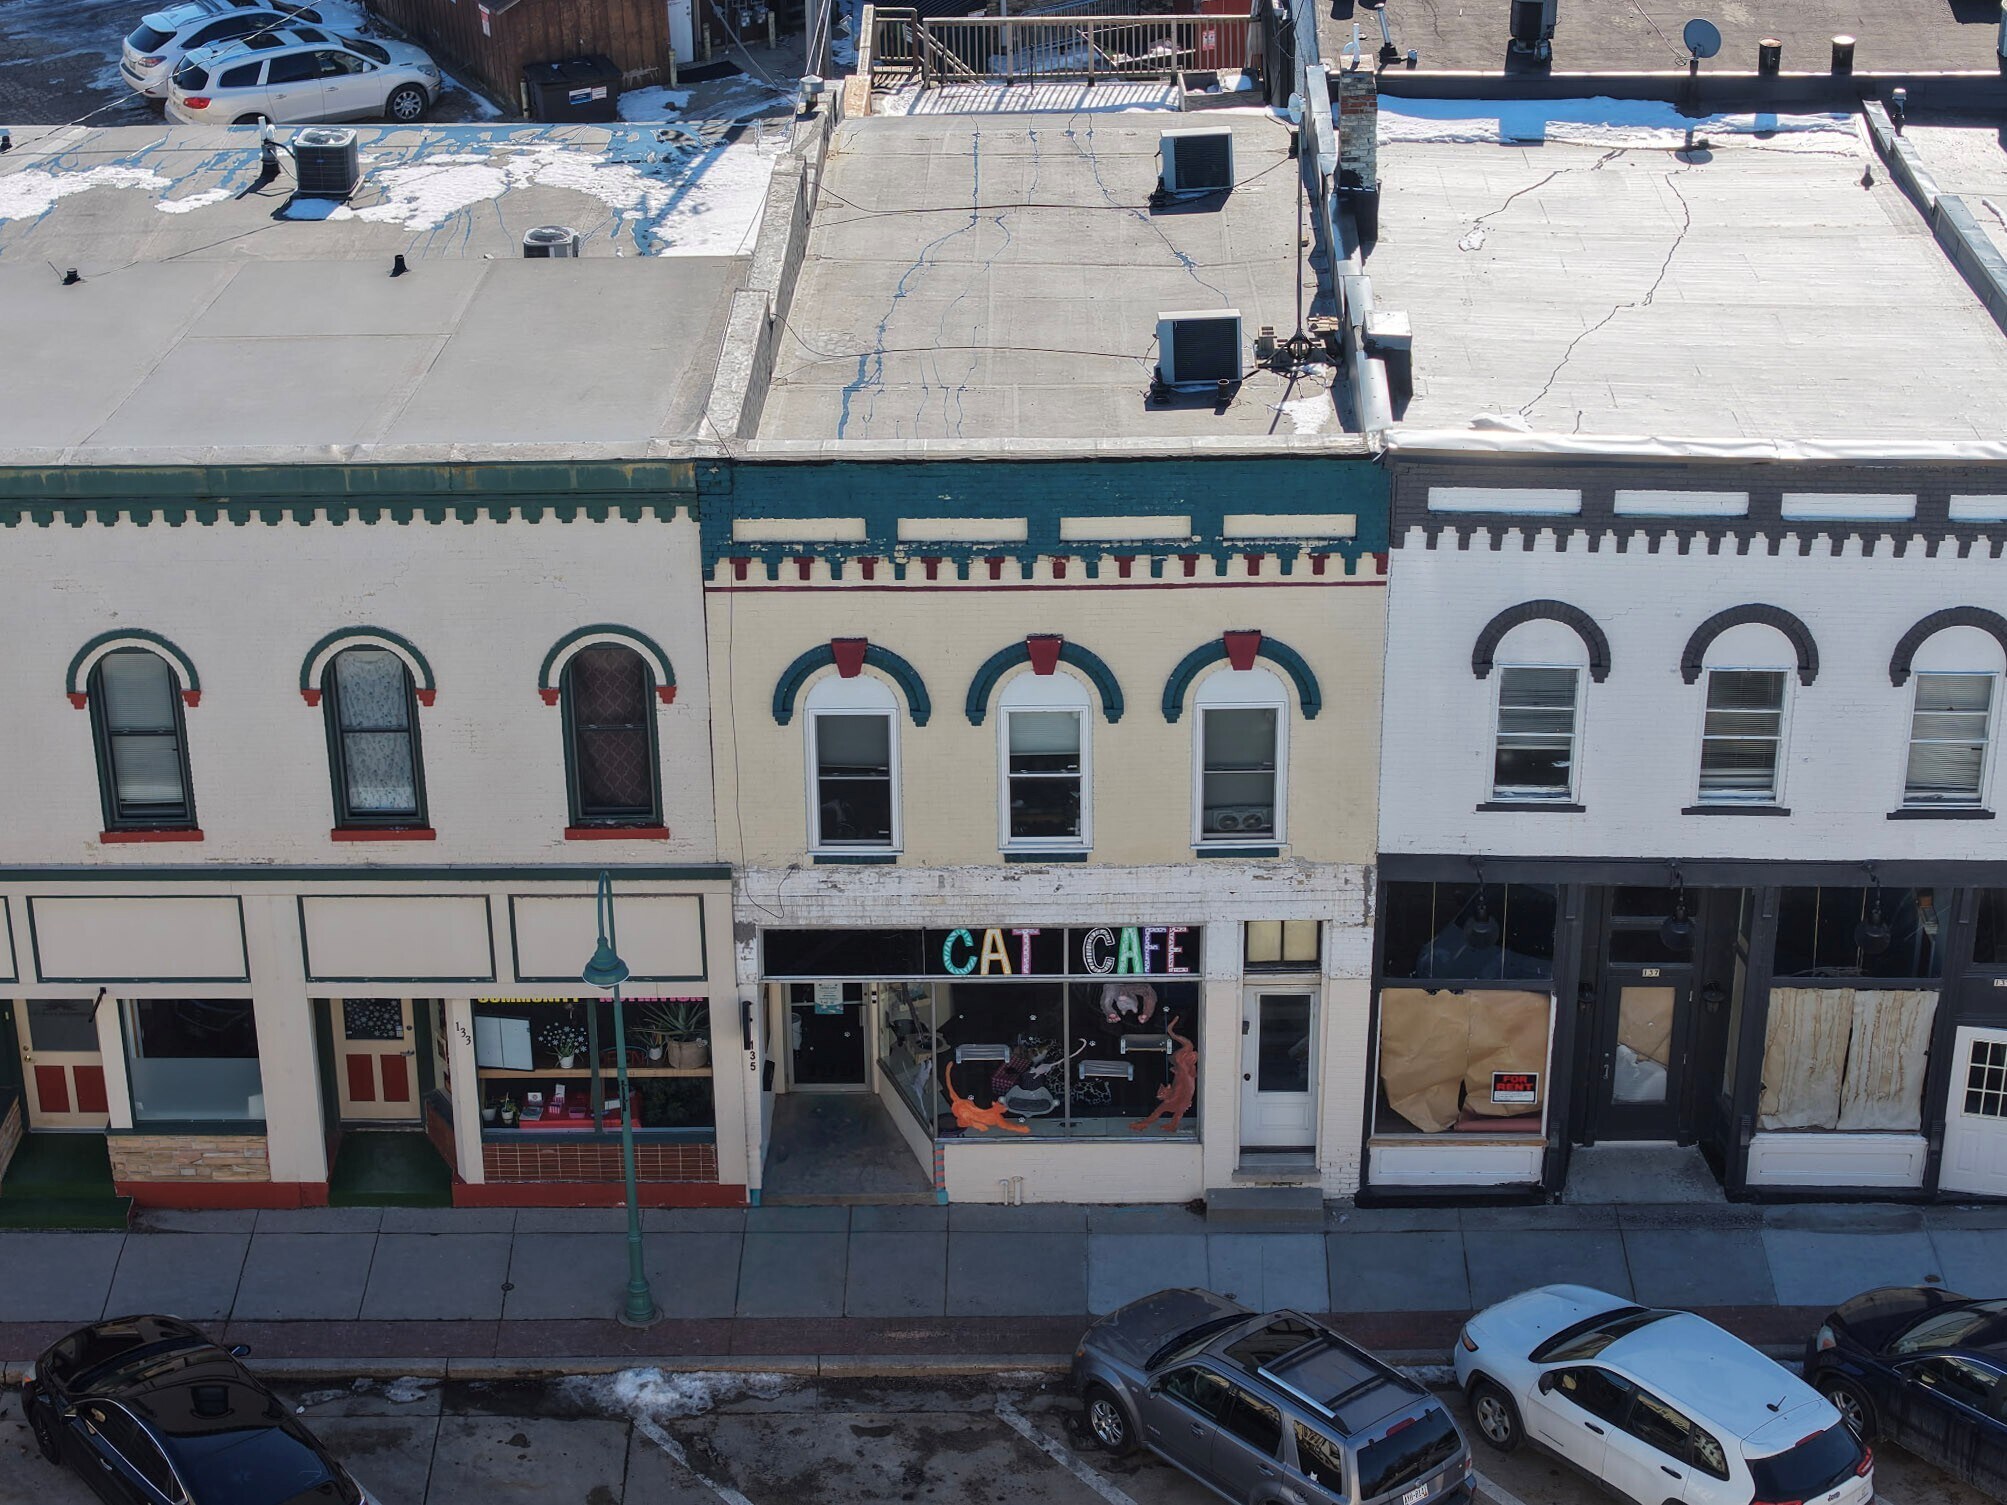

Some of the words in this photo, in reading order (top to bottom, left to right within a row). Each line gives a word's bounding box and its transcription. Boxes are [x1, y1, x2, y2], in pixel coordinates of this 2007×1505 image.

[942, 927, 1041, 975] CAT
[1082, 926, 1189, 975] CAFE
[1643, 969, 1659, 977] 137
[455, 1021, 471, 1046] 133
[1503, 1075, 1528, 1083] FOR
[1496, 1082, 1534, 1091] RENT
